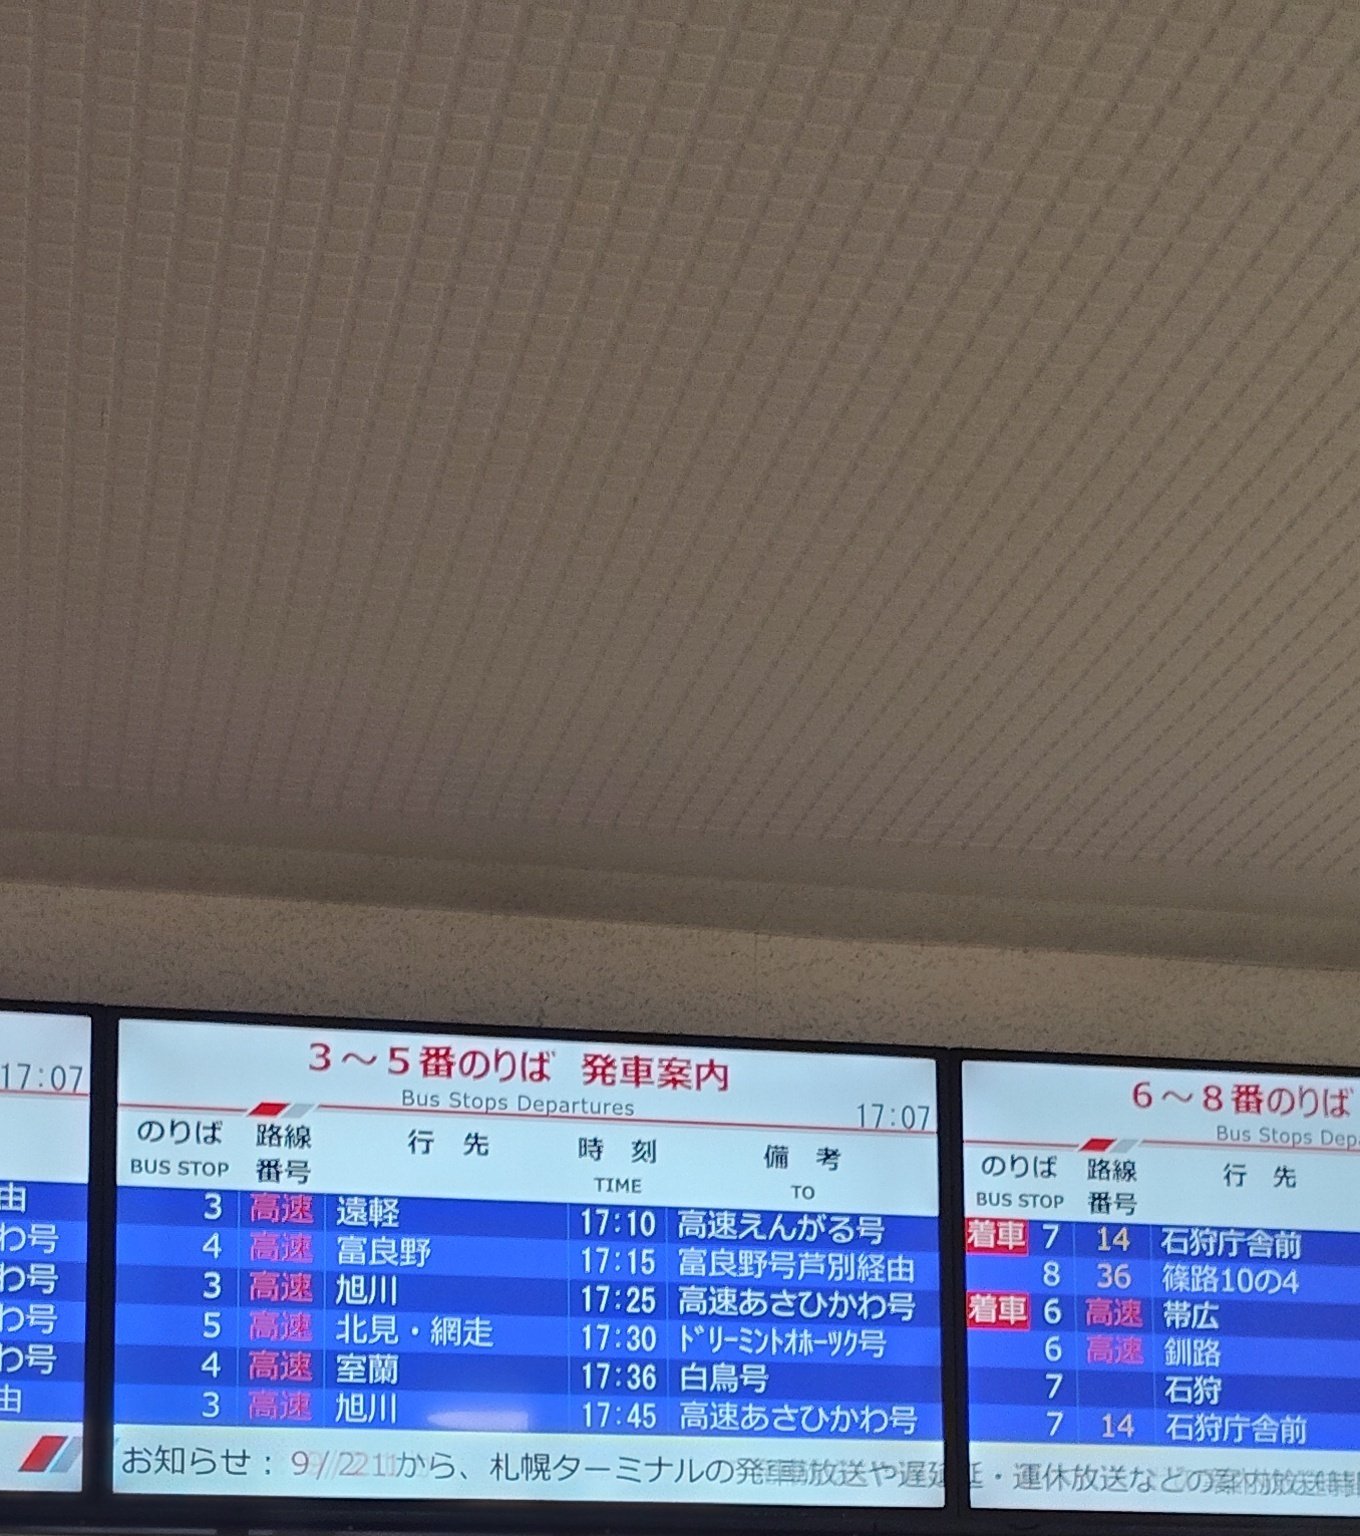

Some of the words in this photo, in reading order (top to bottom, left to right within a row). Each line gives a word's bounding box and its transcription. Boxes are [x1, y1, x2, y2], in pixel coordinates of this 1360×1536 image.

[1, 1063, 84, 1092] 17:07
[582, 1054, 729, 1091] 発車案内
[857, 1103, 931, 1131] 17:07
[250, 1193, 314, 1225] 高速
[337, 1196, 400, 1228] 遠軽
[581, 1209, 655, 1237] 17:10
[678, 1208, 885, 1245] 高速えんがる号
[250, 1232, 313, 1264] 高速
[337, 1236, 430, 1268] 富良野
[581, 1248, 655, 1275] 17:15
[678, 1247, 915, 1284] 富良野号芦別経由
[967, 1221, 1025, 1250] 着車
[1043, 1225, 1059, 1249] 7
[1097, 1227, 1130, 1251] 14
[1162, 1227, 1302, 1259] 石狩庁舎前
[250, 1271, 313, 1303] 高速
[336, 1275, 398, 1306] 旭川
[582, 1286, 655, 1314] 17:25
[678, 1286, 916, 1321] 高速あさひかわ号
[1043, 1262, 1060, 1287] 8
[1097, 1264, 1131, 1289] 36
[1163, 1268, 1299, 1294] 篠路10の4
[249, 1310, 313, 1342] 高速
[336, 1314, 493, 1348] 北見・網走
[582, 1324, 656, 1352] 17:30
[968, 1295, 1028, 1323] 着車
[1044, 1298, 1061, 1324] 6
[1086, 1298, 1142, 1328] 高速
[1163, 1301, 1219, 1330] 帯広
[1045, 1336, 1062, 1361] 6
[1087, 1336, 1144, 1365] 高速
[1165, 1338, 1221, 1367] 釧路
[249, 1350, 313, 1382] 高速
[336, 1354, 400, 1385] 室蘭
[582, 1363, 657, 1391] 17:36
[680, 1363, 769, 1393] 白鳥号
[1046, 1373, 1063, 1398] 7
[1165, 1375, 1222, 1404] 石狩
[248, 1390, 313, 1421] 高速
[336, 1394, 398, 1424] 旭川
[582, 1401, 657, 1429] 17:45
[680, 1401, 918, 1435] 高速あさひかわ号
[1047, 1413, 1064, 1437] 7
[1102, 1413, 1134, 1438] 14
[1166, 1413, 1308, 1445] 石狩庁舎前
